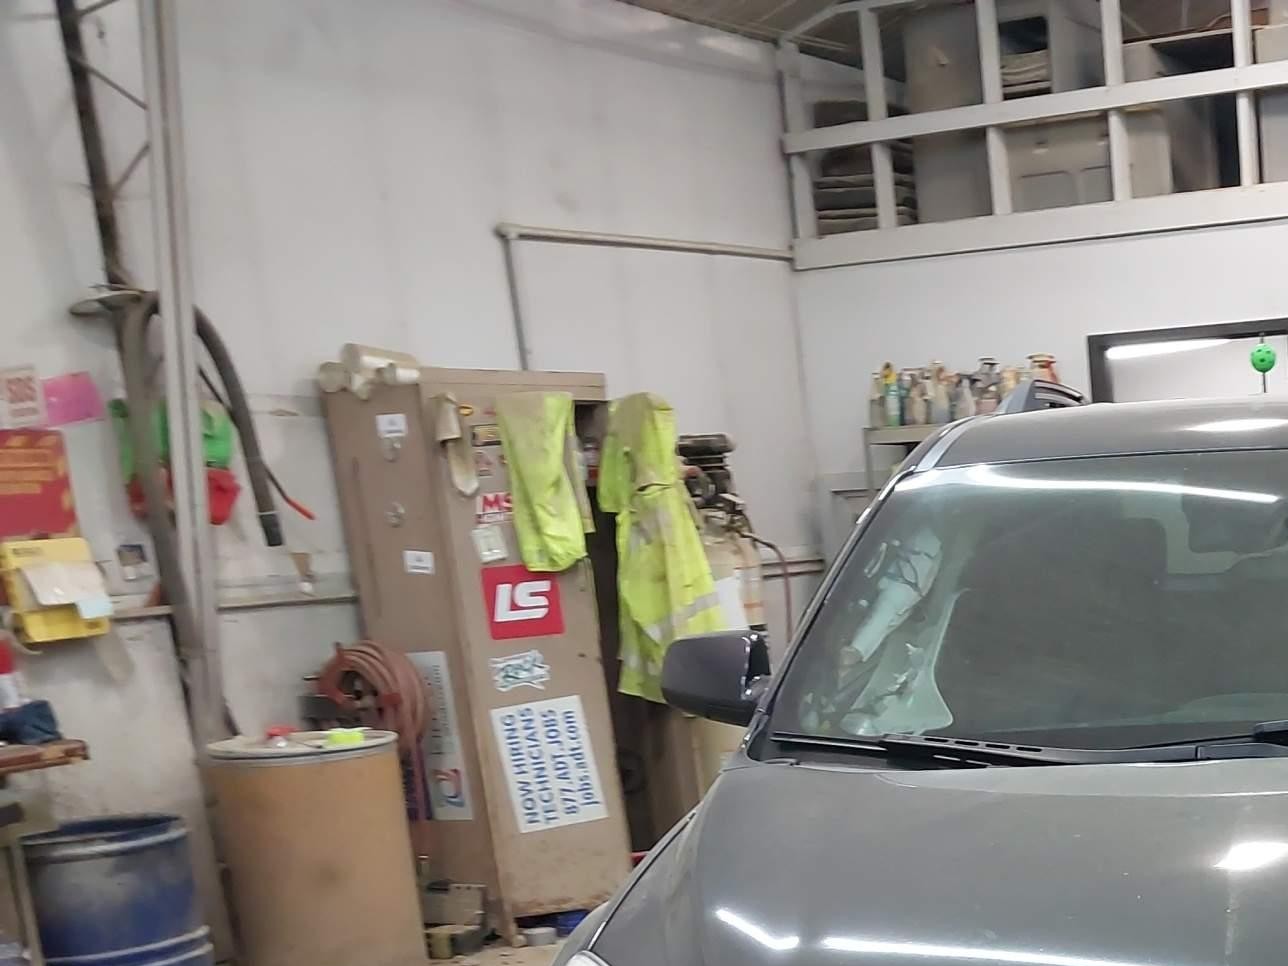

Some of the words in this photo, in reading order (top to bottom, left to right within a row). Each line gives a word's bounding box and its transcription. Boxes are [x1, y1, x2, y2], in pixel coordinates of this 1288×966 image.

[493, 580, 551, 623] LS
[500, 714, 529, 775] HIRING
[518, 707, 559, 824] TECHNICIANS
[540, 709, 579, 815] 877.ADT.JOBS
[562, 710, 601, 806] jobs.adt.com
[517, 780, 541, 824] NOW
